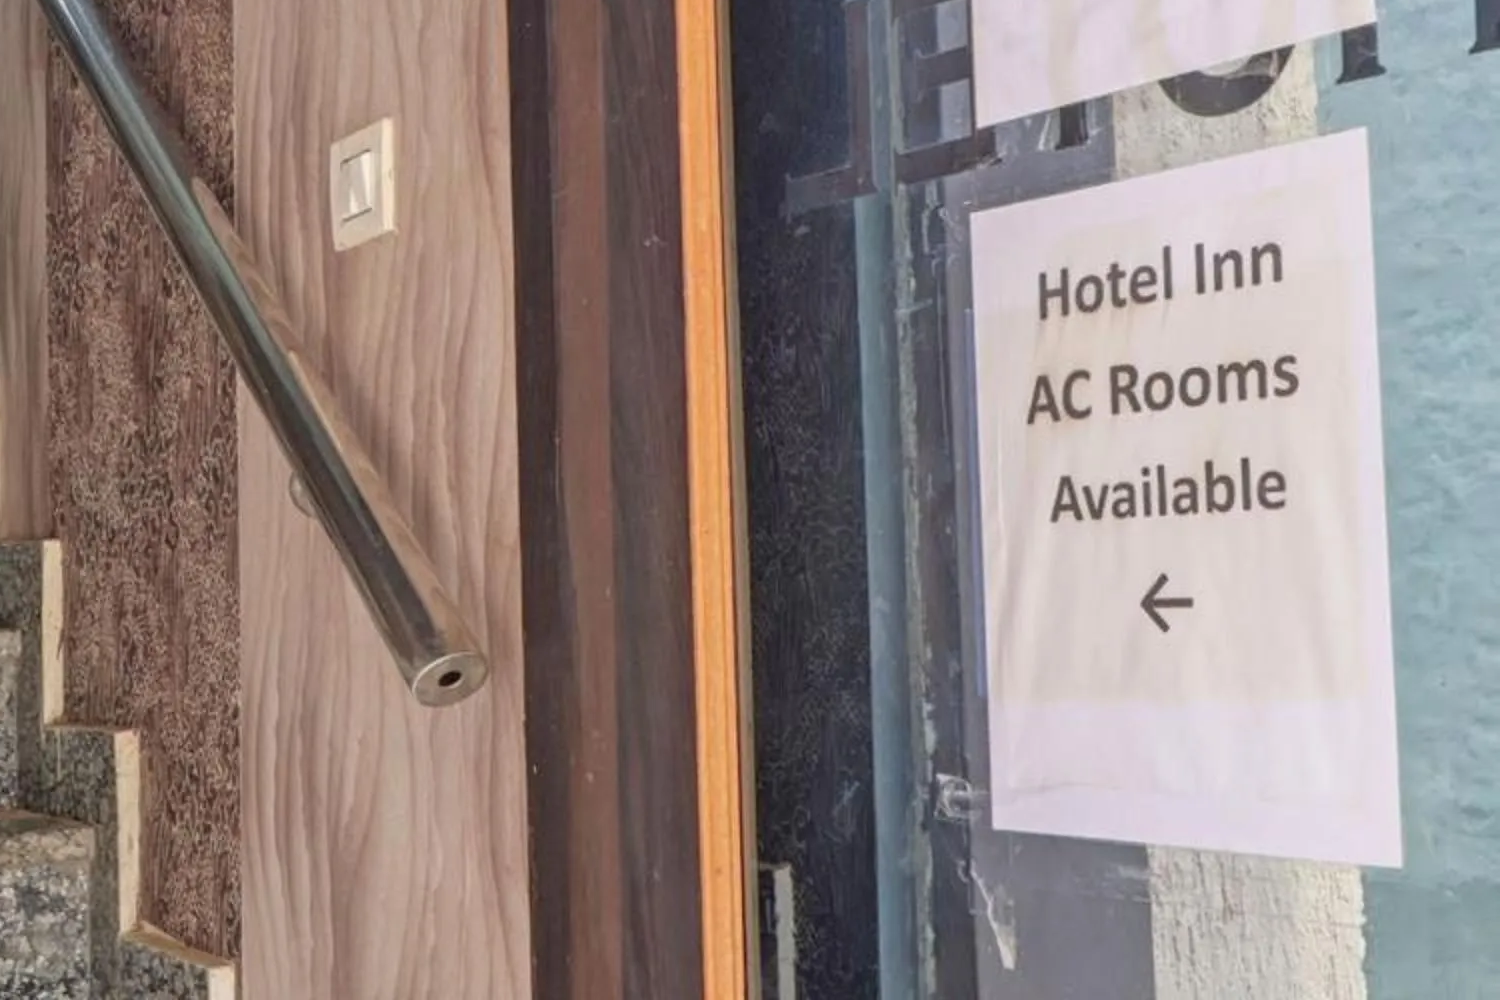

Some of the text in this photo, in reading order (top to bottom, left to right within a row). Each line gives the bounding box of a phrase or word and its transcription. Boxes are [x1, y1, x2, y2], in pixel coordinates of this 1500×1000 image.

[1038, 242, 1283, 321] Hotel Inn
[1027, 355, 1299, 425] AC Rooms
[1050, 457, 1286, 523] Available
